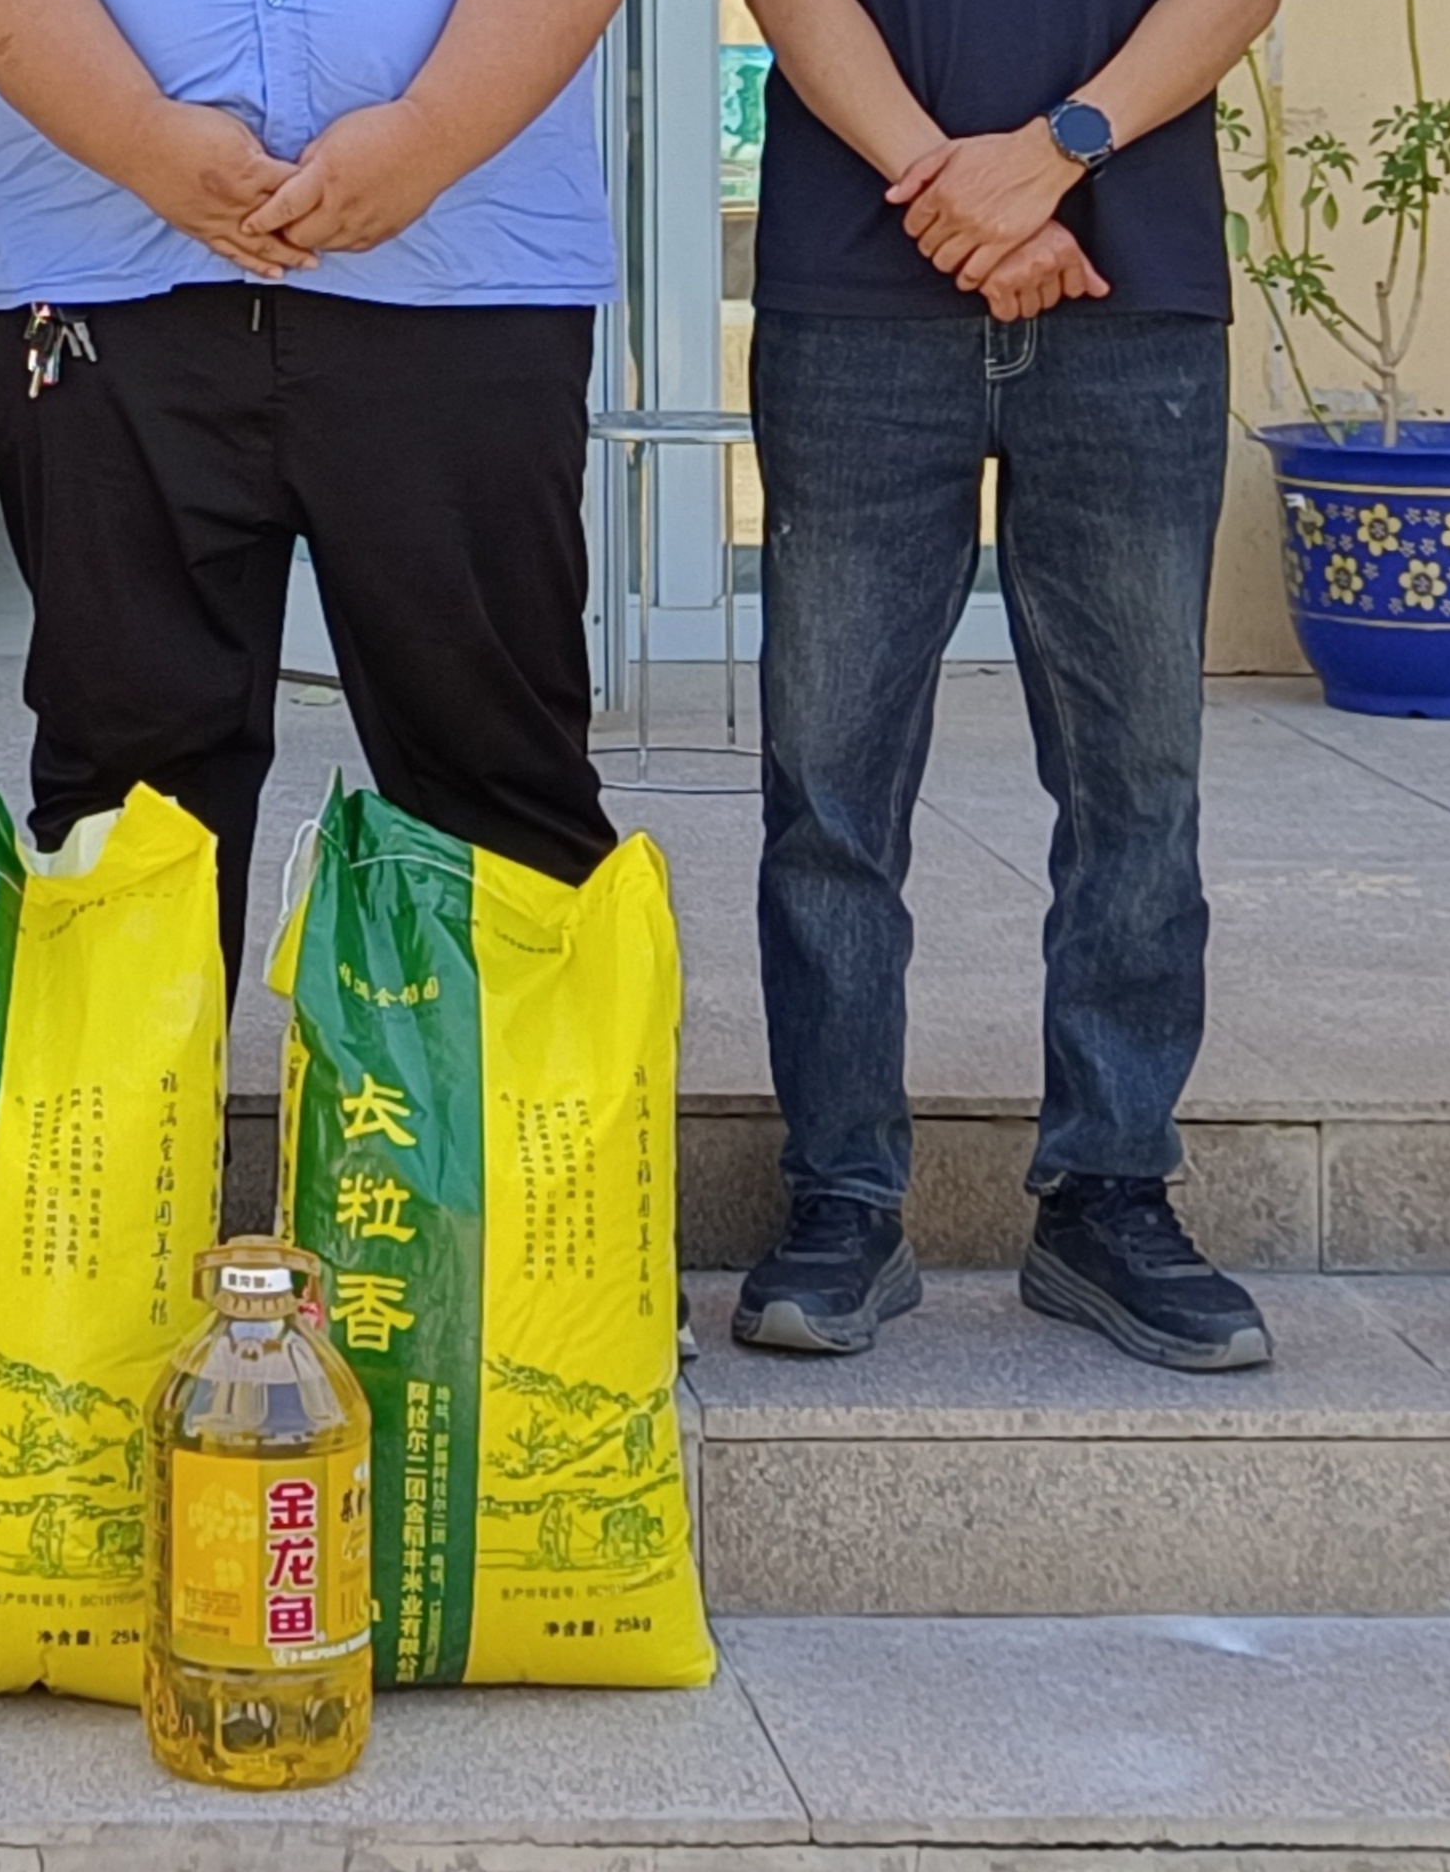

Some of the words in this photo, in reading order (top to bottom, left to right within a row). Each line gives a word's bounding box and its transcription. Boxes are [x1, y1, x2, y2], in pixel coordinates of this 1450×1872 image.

[330, 1074, 416, 1352] 长粒香
[268, 1482, 317, 1644] 金龙鱼
